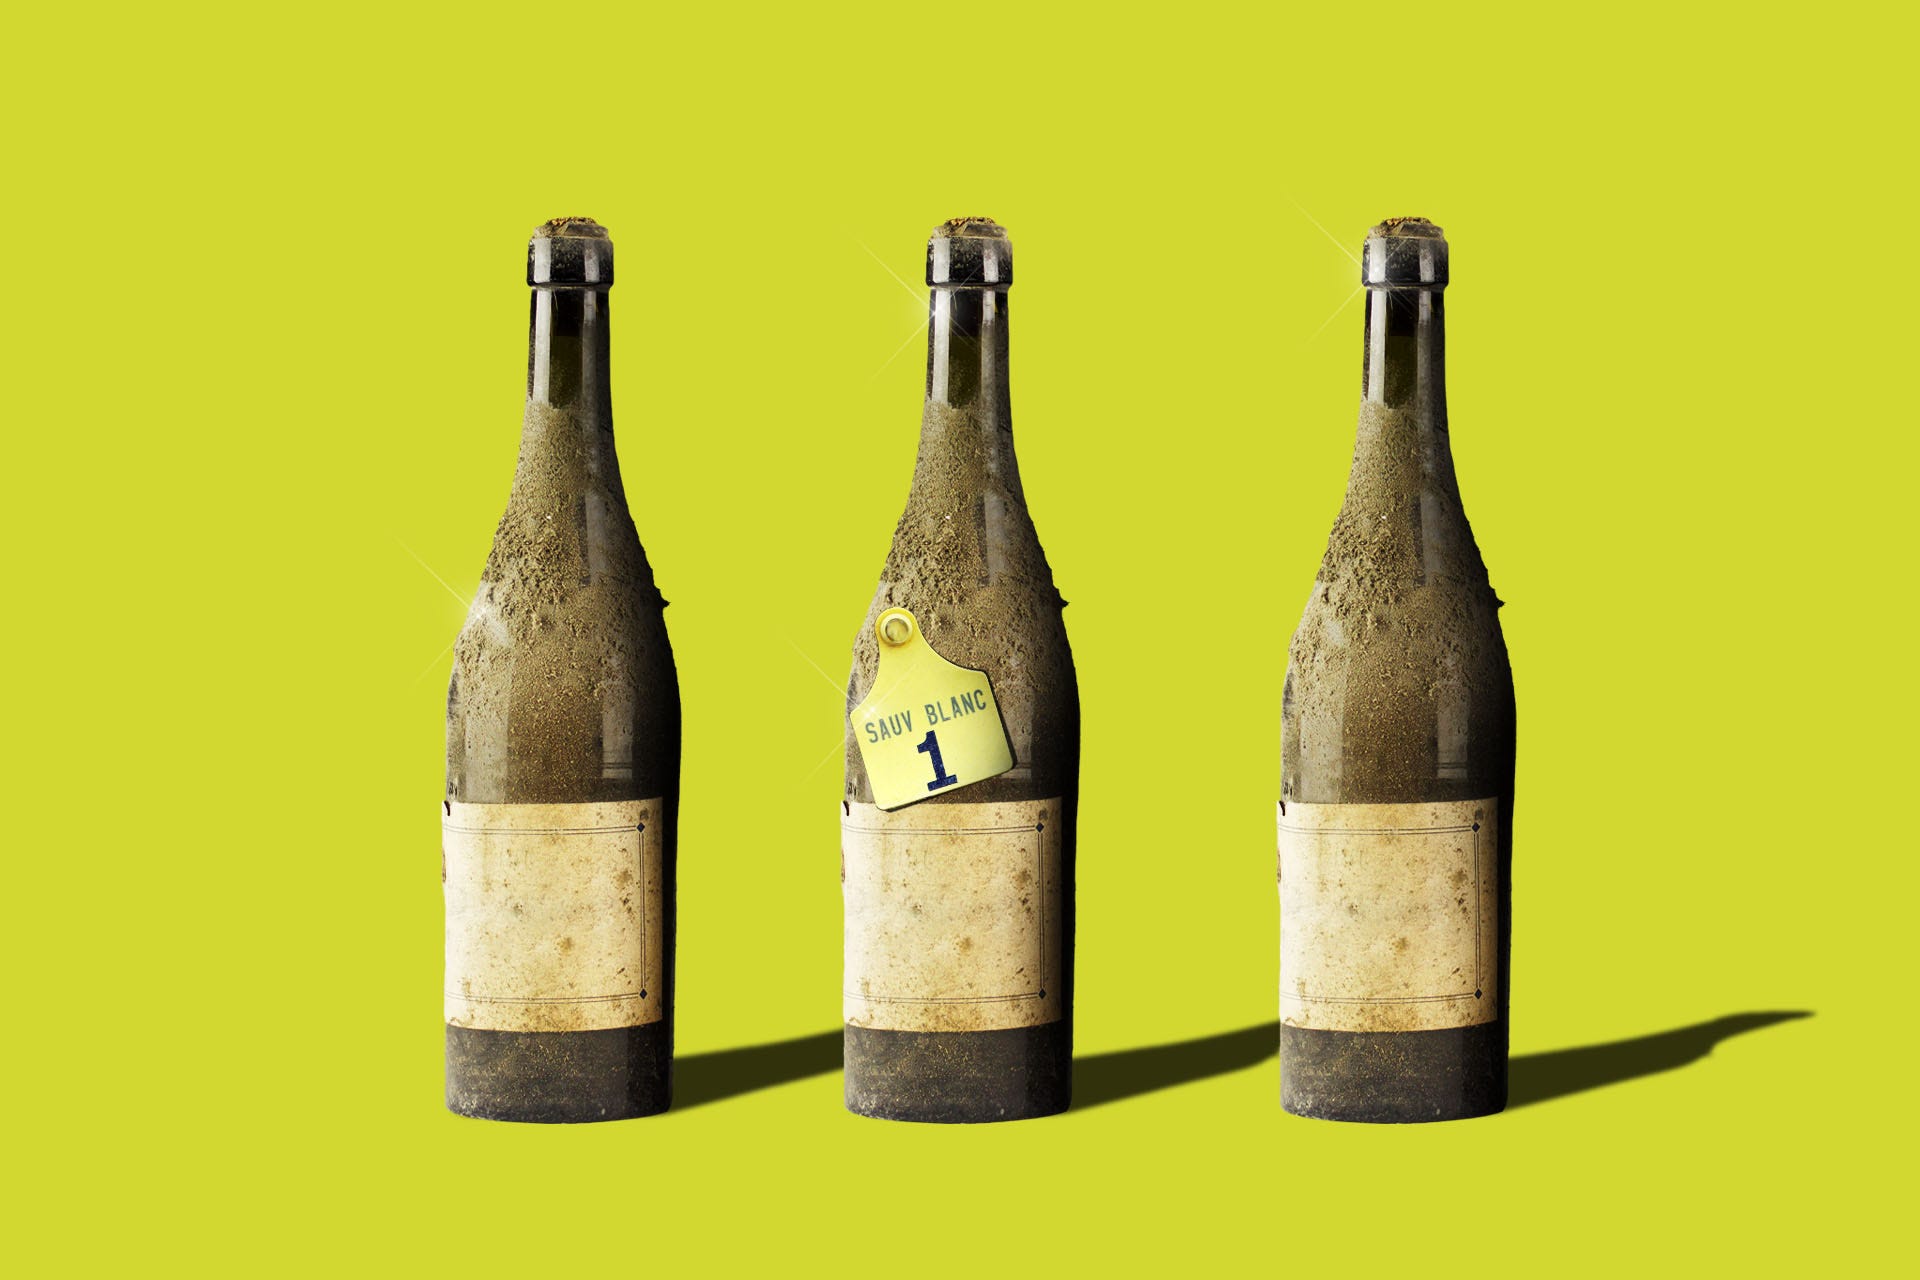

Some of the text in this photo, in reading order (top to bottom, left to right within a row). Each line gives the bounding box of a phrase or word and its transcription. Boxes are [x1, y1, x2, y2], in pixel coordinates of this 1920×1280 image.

[865, 689, 987, 743] SAUV BLANC
[917, 730, 958, 791] 1
